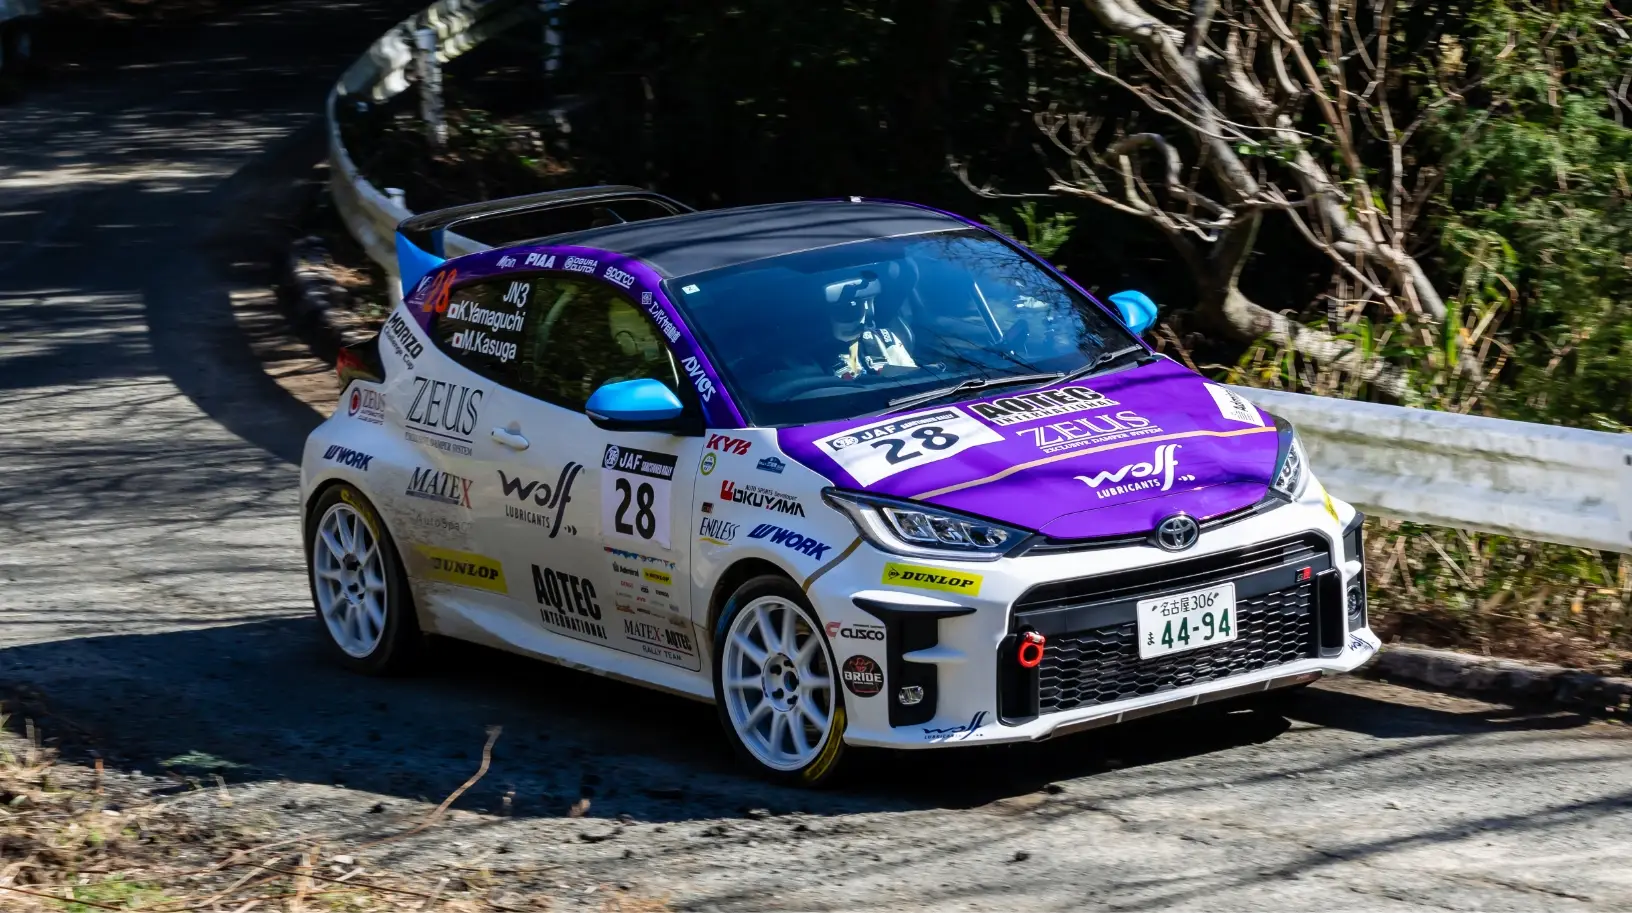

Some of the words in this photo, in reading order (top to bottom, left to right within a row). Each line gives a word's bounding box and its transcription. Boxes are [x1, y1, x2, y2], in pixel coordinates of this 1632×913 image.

[525, 253, 556, 268] PIAA
[571, 263, 595, 274] CLUTCH
[573, 257, 598, 267] OGURA
[605, 266, 635, 287] sparco
[422, 269, 457, 312] 28
[503, 281, 530, 308] JN3
[457, 300, 526, 332] K.Yamaguchi
[388, 312, 424, 360] MORIZO
[461, 329, 518, 362] M.Kasuga
[405, 376, 484, 436] ZEUS
[969, 387, 1104, 419] AQTEC
[996, 399, 1118, 424] INTERNATIONAL
[861, 425, 896, 440] JAF
[1016, 410, 1151, 447] ZEUS
[706, 433, 752, 455] KYB
[870, 426, 960, 466] 28
[1043, 439, 1092, 454] EXCLUSIVE
[1092, 433, 1131, 445] DAMPER
[336, 448, 374, 471] WORK
[620, 452, 642, 470] JAF
[405, 466, 474, 509] MATEX
[1097, 479, 1161, 499] LUBRICANTS
[615, 477, 656, 540] 28
[732, 488, 806, 518] OKUYAMA
[505, 504, 550, 529] LUBRICANTS
[700, 517, 740, 541] ENDLESS
[769, 525, 832, 561] WORK
[531, 563, 602, 620] AQTEC
[900, 571, 974, 588] DUNLOP
[540, 608, 607, 640] INTERNATIONAL
[841, 627, 885, 641] CUSCO
[1147, 632, 1155, 646] ま
[1161, 608, 1231, 649] 44-94
[642, 644, 661, 655] RALLY
[663, 650, 682, 661] TEAM
[844, 671, 883, 683] BRIDE
